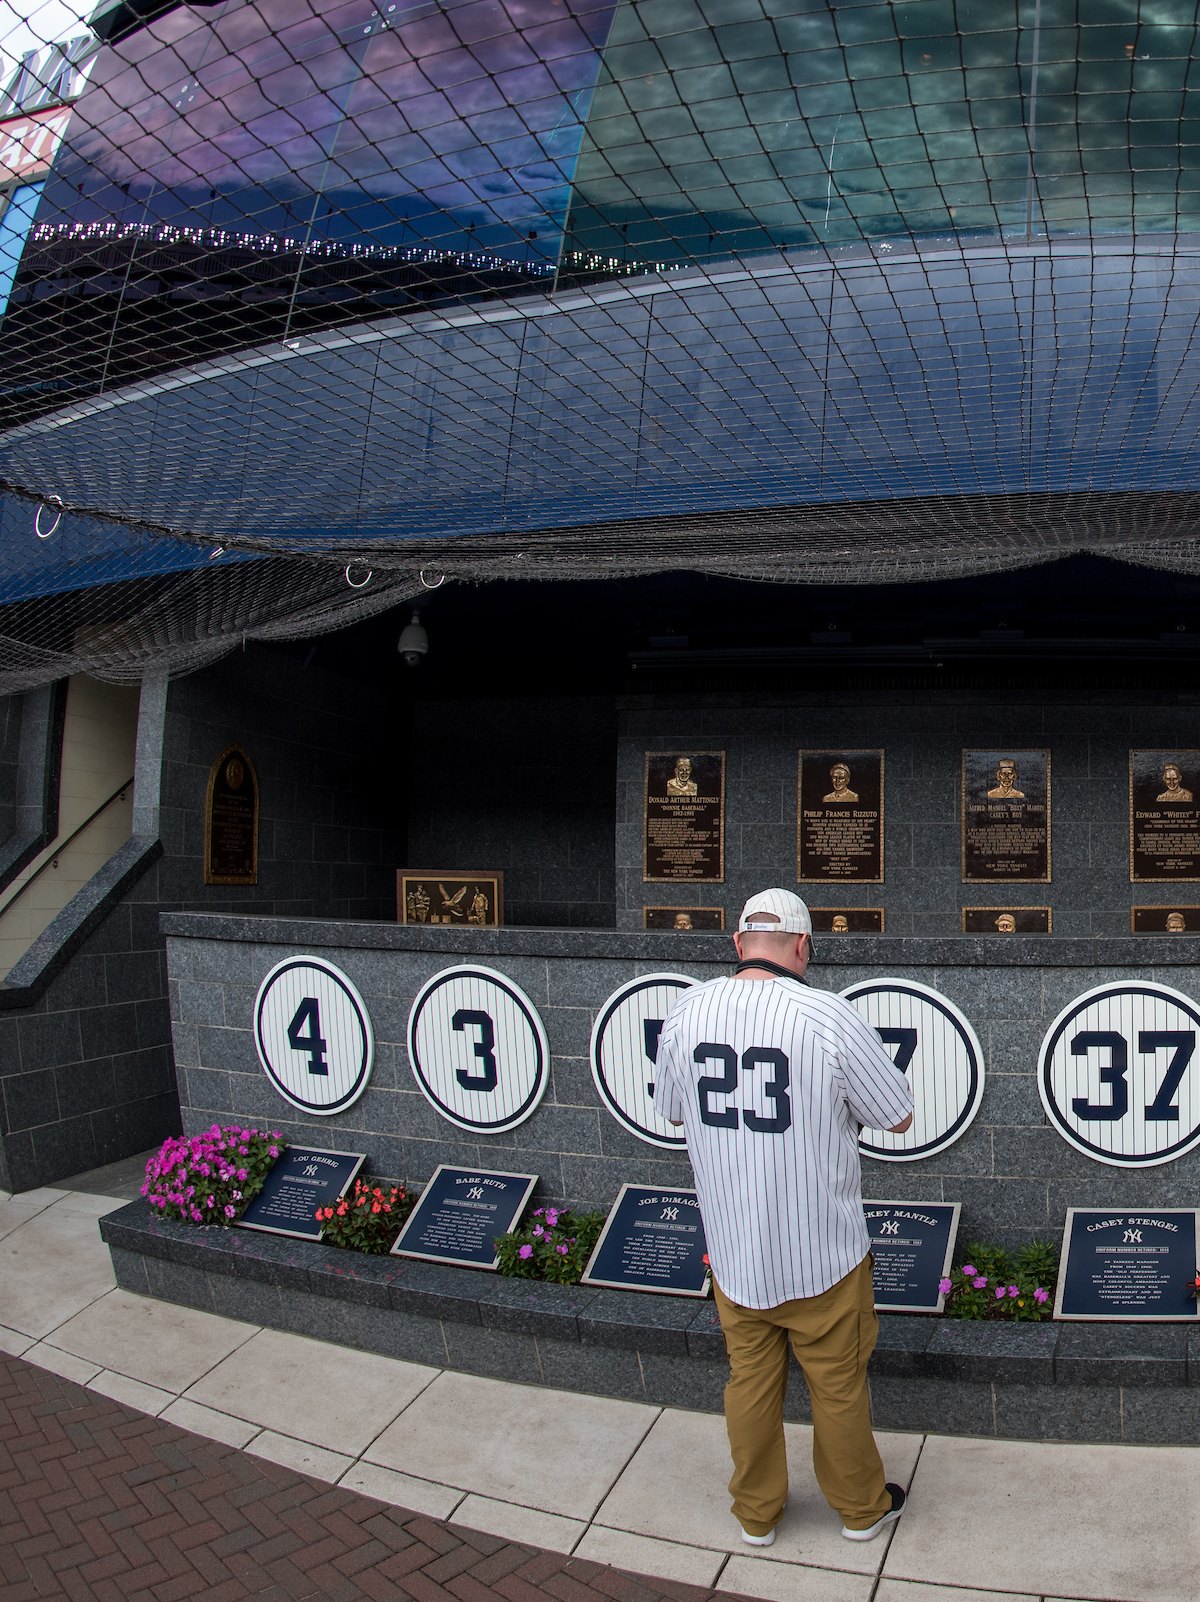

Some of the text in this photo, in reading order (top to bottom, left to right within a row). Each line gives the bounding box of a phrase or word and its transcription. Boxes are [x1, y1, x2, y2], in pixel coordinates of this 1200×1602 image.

[288, 997, 328, 1076] 4
[452, 1009, 497, 1092] 3
[1071, 1031, 1196, 1120] 37
[694, 1042, 791, 1133] 23
[311, 1155, 339, 1168] GEHRIG
[482, 1179, 508, 1190] RUTH
[638, 1197, 658, 1206] JOE
[894, 1210, 938, 1226] MANTLE
[1086, 1218, 1179, 1232] CASEY STENGEL
